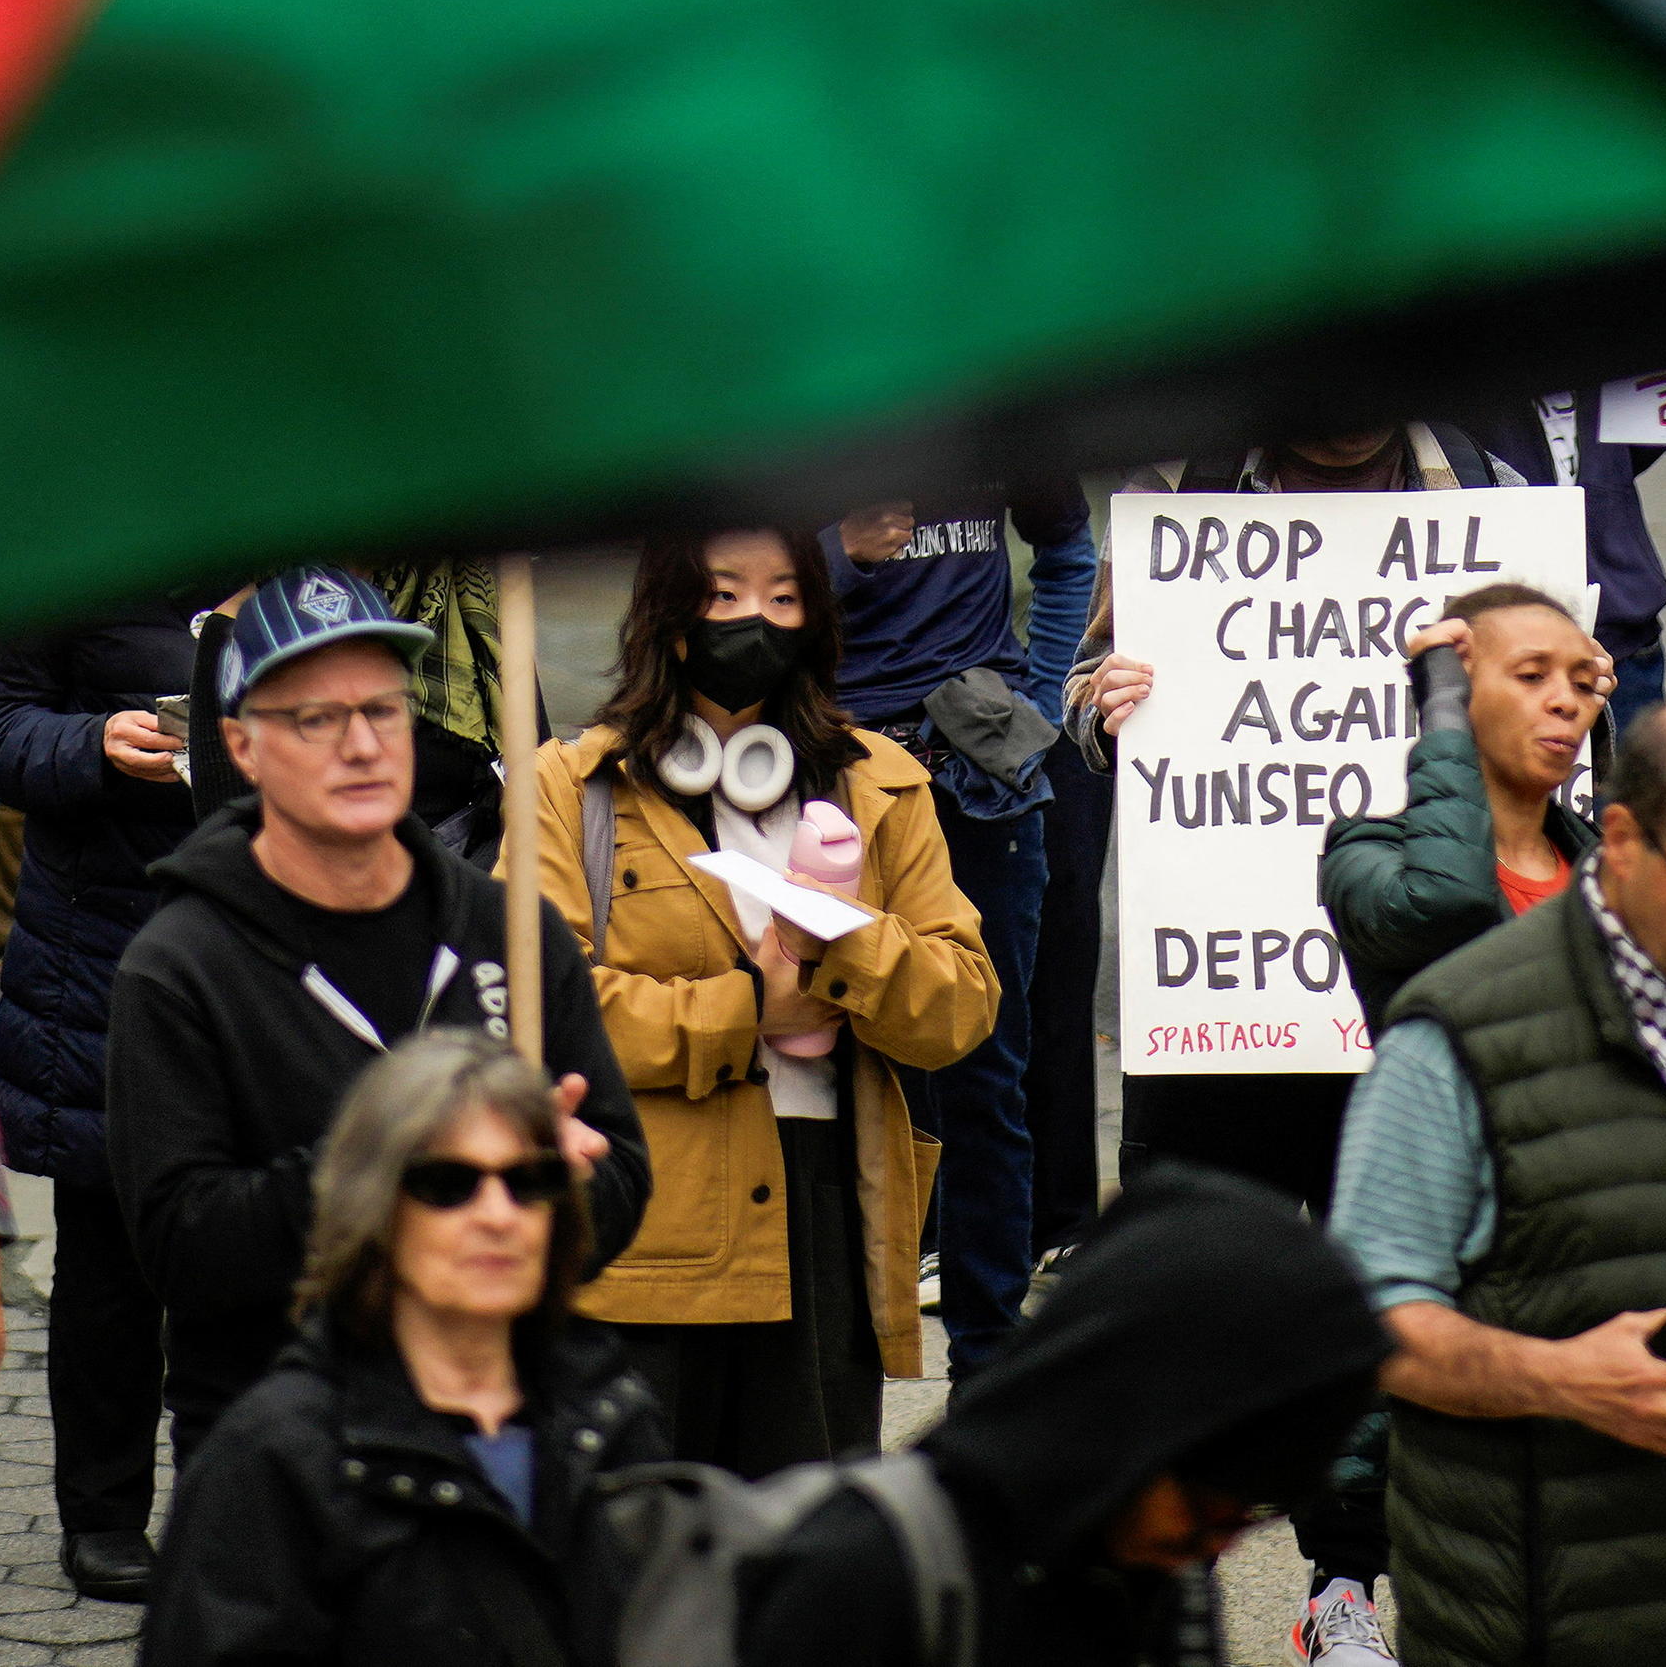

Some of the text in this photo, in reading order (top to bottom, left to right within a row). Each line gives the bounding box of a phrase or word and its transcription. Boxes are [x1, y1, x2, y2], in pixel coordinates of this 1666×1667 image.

[1150, 514, 1503, 582] DROP ALL
[1131, 757, 1372, 829] YUNSEO
[1147, 1019, 1301, 1057] SPARTACUS
